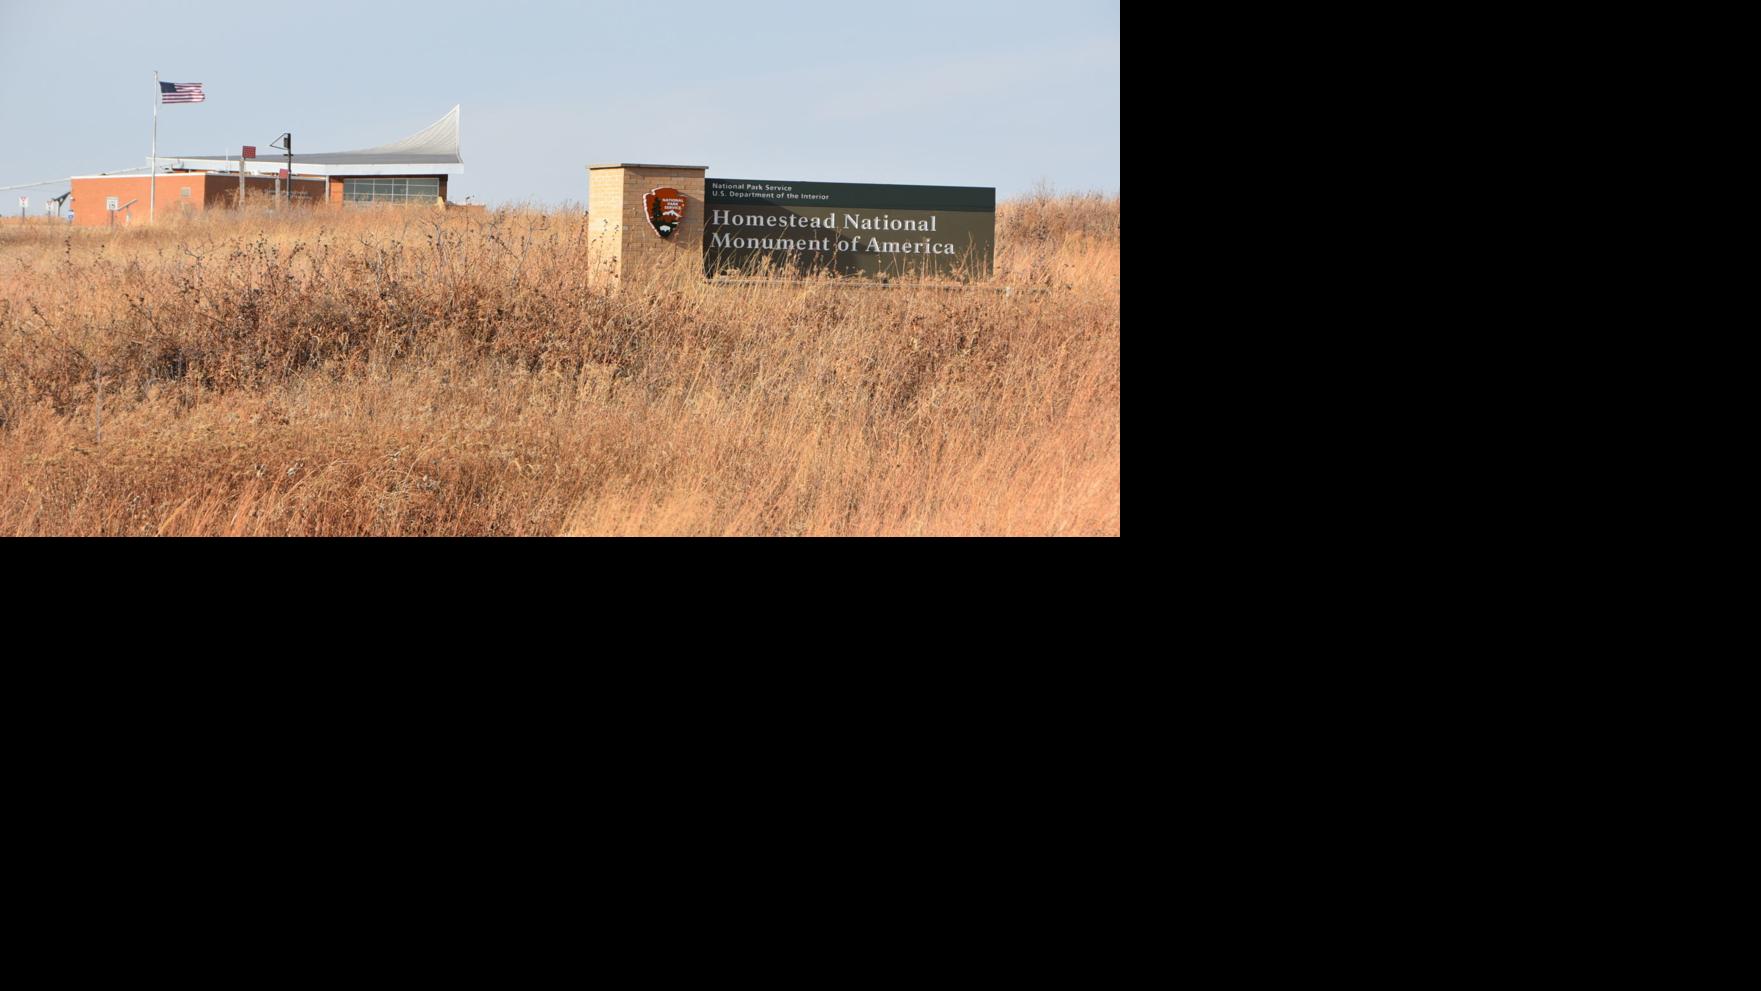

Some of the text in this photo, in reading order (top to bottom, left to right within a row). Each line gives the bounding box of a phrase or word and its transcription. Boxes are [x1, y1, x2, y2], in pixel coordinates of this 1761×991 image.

[729, 191, 775, 199] Department
[712, 209, 937, 232] Homestead National
[711, 231, 955, 255] Monument of America
